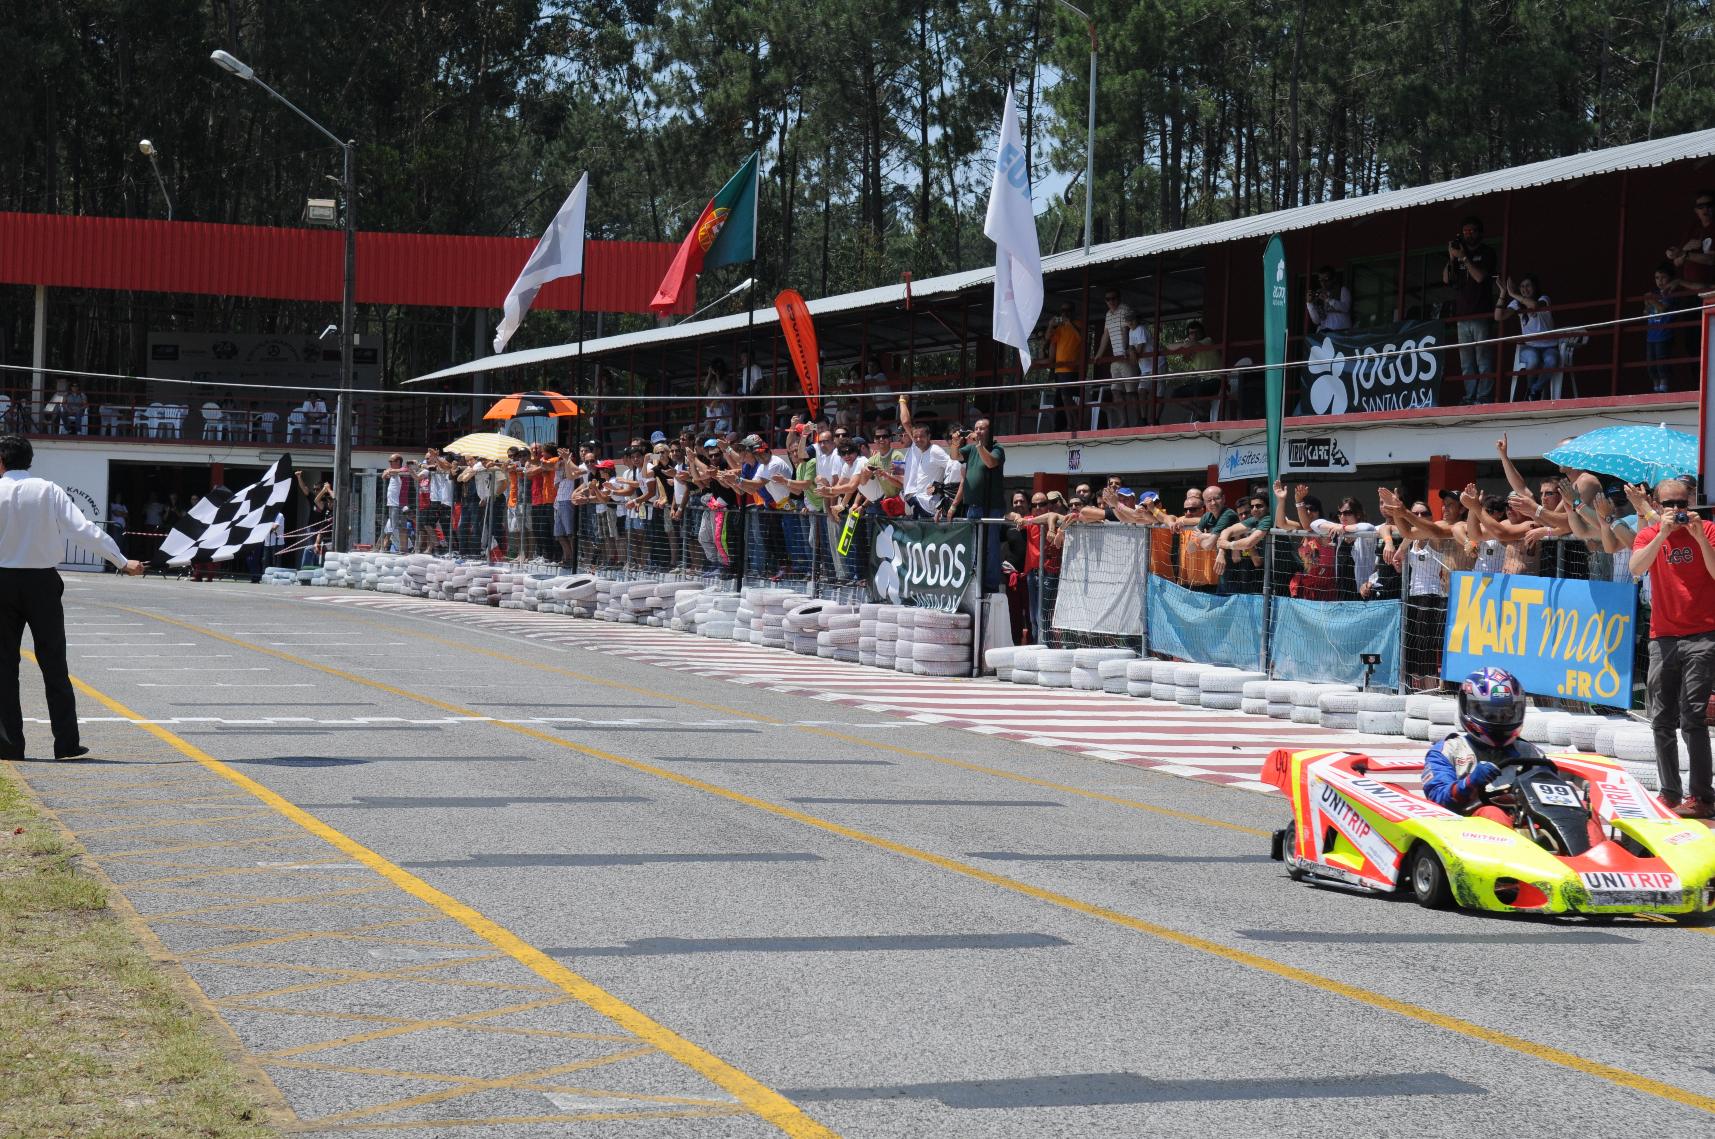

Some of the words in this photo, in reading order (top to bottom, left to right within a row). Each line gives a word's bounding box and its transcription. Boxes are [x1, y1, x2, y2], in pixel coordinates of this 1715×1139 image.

[1352, 335, 1437, 406] JOGOS
[66, 486, 100, 516] KARTING
[903, 541, 966, 598] JOGOS
[1662, 544, 1694, 564] Lee
[1351, 778, 1453, 819] UNITRIP
[1538, 784, 1569, 796] 99
[1321, 784, 1371, 838] UNITRIP
[1585, 872, 1673, 889] UNITRIP
